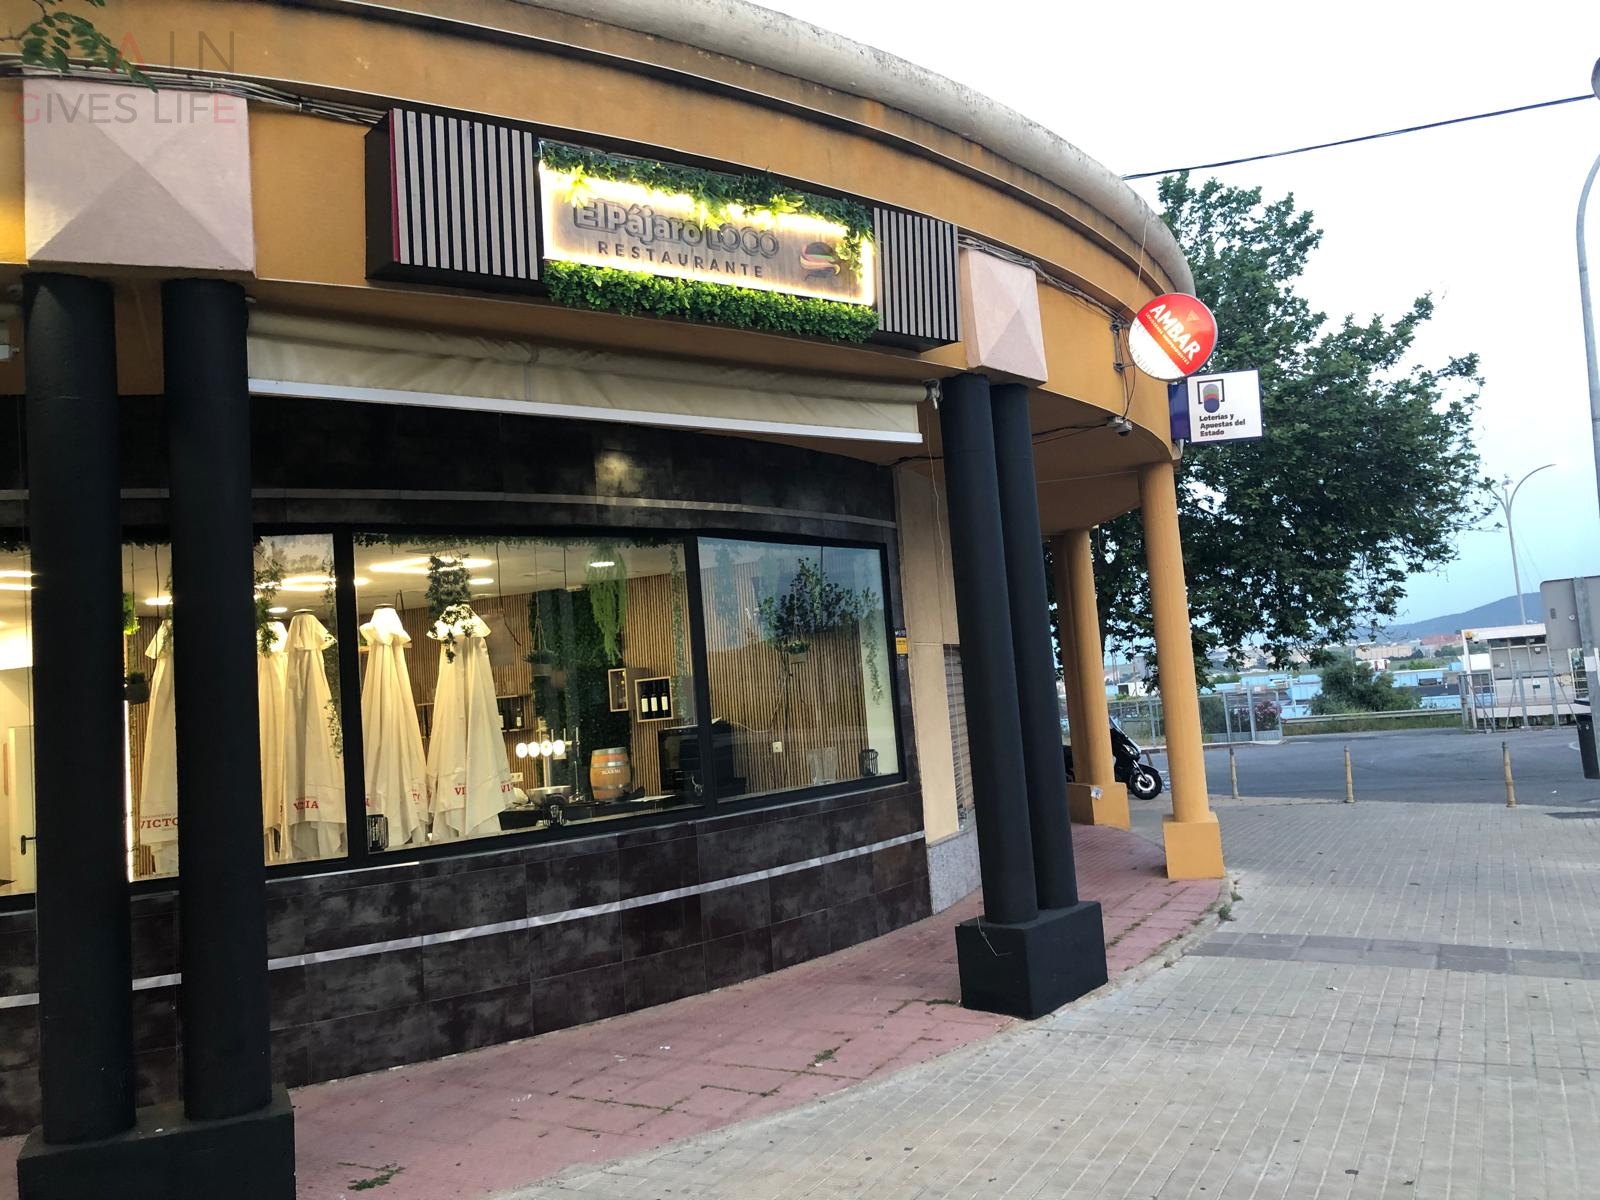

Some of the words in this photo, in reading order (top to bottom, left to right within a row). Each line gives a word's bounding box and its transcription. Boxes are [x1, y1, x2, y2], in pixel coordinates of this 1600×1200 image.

[598, 240, 763, 278] RESTAURANTE
[1149, 303, 1201, 362] AMBAR
[1200, 421, 1233, 430] Apuestas
[1234, 419, 1246, 427] del
[1200, 429, 1225, 437] Estado
